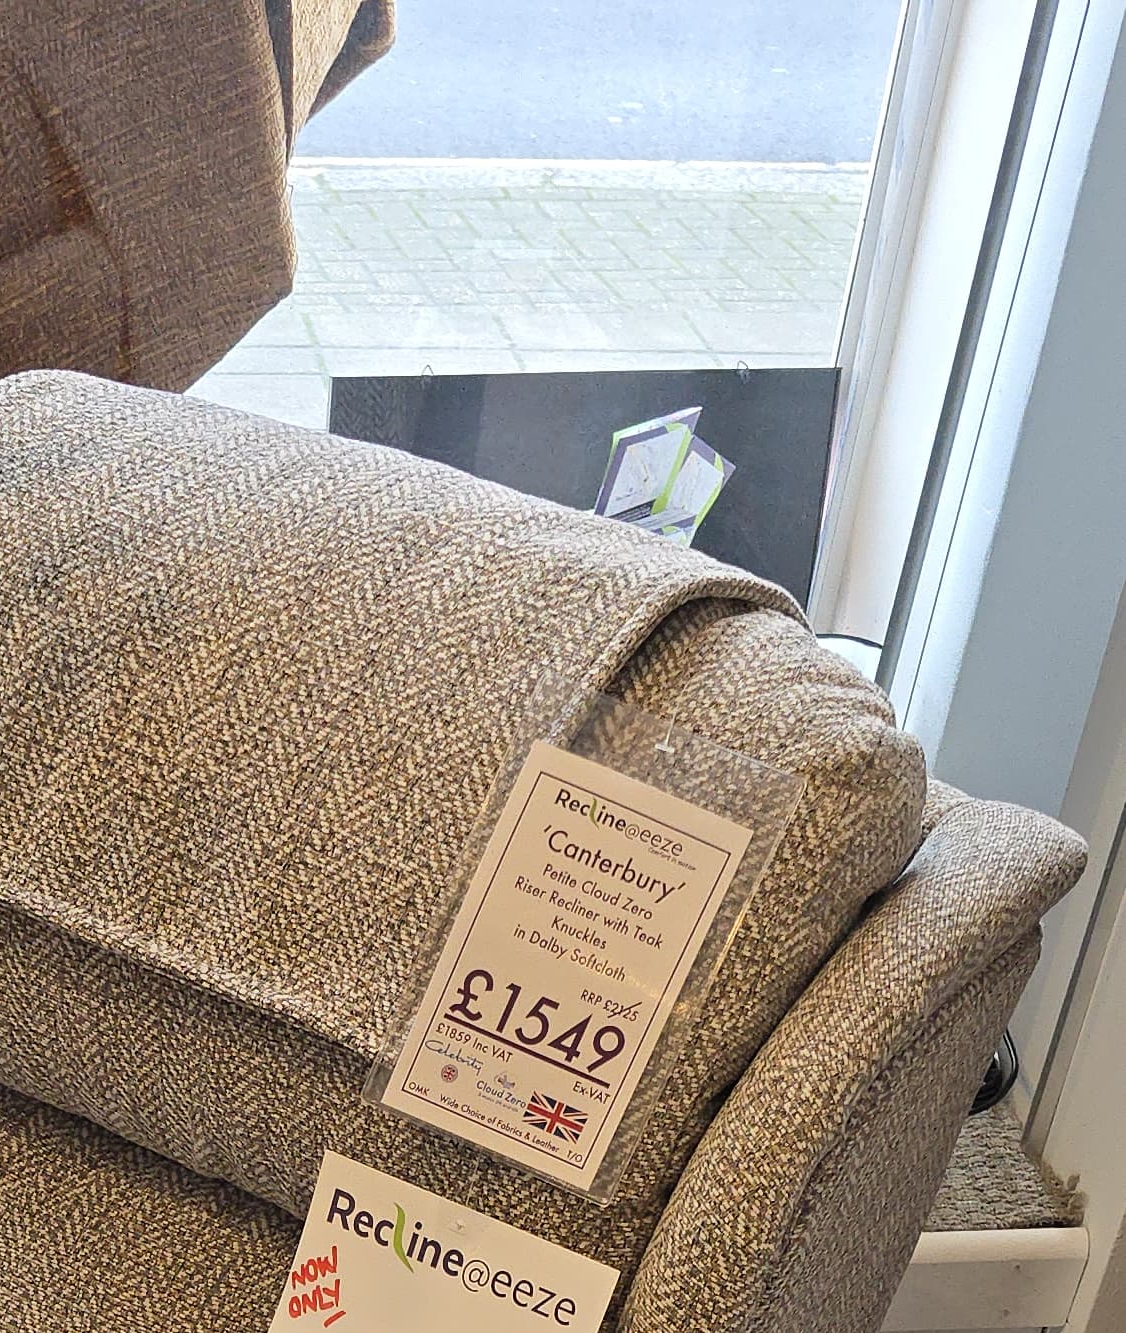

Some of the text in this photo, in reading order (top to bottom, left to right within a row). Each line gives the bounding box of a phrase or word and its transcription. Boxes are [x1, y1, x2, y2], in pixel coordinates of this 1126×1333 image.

[554, 788, 683, 858] Recline@eeze
[514, 875, 663, 949] Riser Recliner with Teak
[542, 863, 653, 920] Petite Cloud Zero
[513, 924, 626, 982] in Dalby Softcloth
[551, 915, 607, 950] Knuckles
[581, 989, 603, 1006] RRP
[436, 1022, 513, 1063] £1859 Inc VAT
[449, 969, 625, 1073] £1549
[425, 1040, 484, 1076] Celebrity
[476, 1080, 505, 1099] Cloud
[504, 1091, 526, 1108] Zero
[573, 1081, 611, 1105] Ex-VAT
[440, 1094, 459, 1109] Wide
[461, 1104, 486, 1121] Choice
[487, 1116, 497, 1125] of
[496, 1119, 523, 1137] Fabrics
[523, 1132, 530, 1140] &
[531, 1134, 559, 1153] Leather
[291, 1246, 338, 1290] NOW
[327, 1188, 577, 1326] Recline@eeze
[288, 1279, 342, 1319] ONLY
